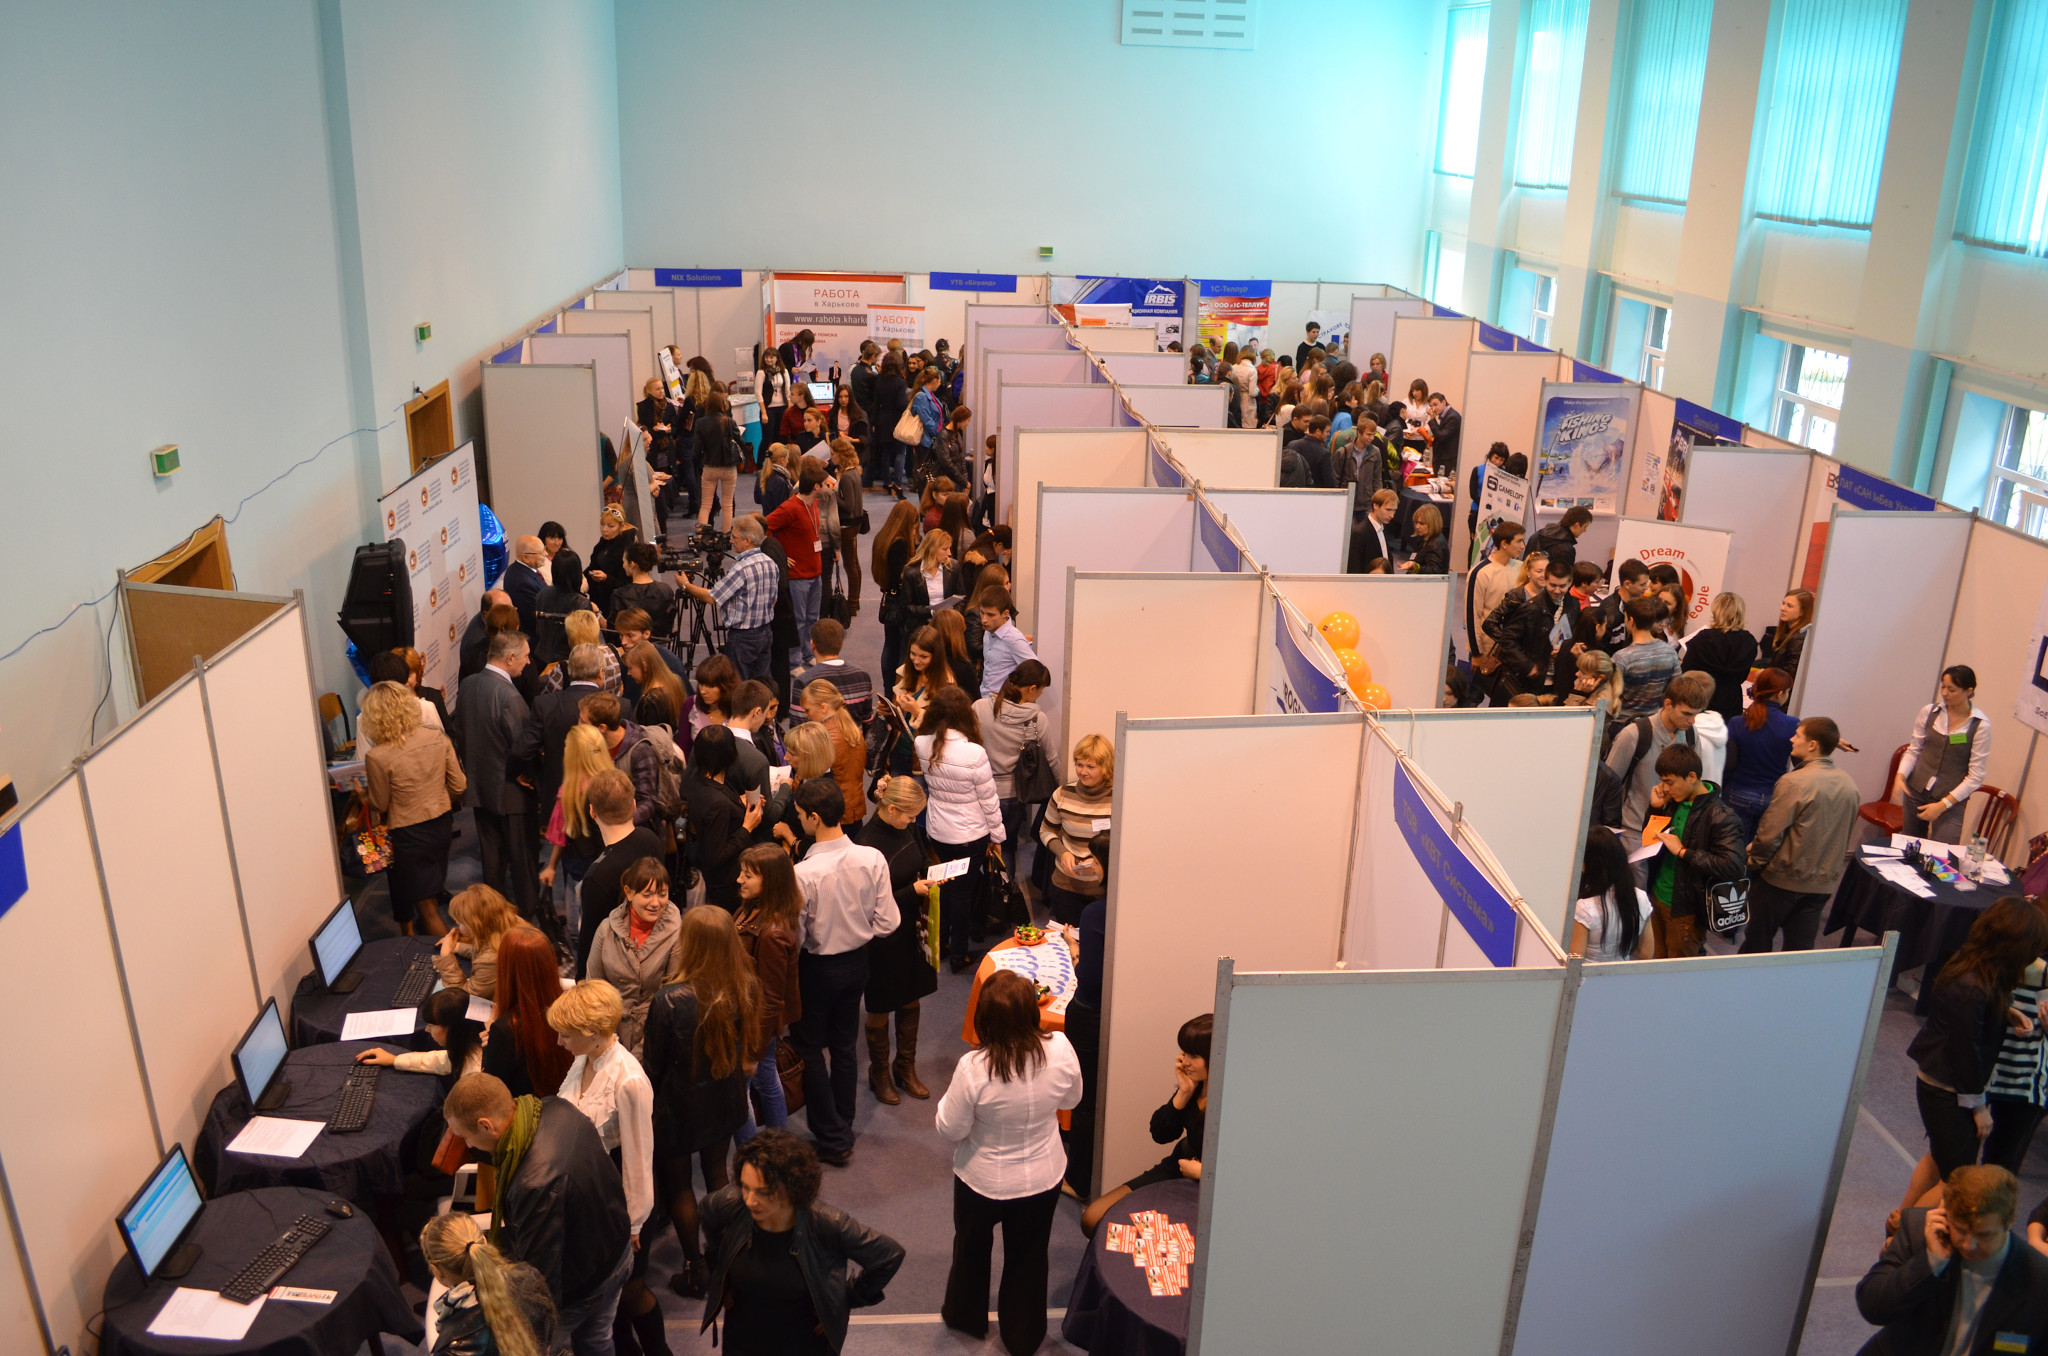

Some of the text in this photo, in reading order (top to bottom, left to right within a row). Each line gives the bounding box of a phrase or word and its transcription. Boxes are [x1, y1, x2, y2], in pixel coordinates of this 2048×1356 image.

[813, 288, 860, 299] РАБОТА
[1144, 295, 1176, 304] IRBIS
[821, 300, 860, 308] Харькове
[875, 315, 916, 325] РАБОТА
[882, 325, 916, 334] Харькове
[1560, 411, 1613, 431] FISHING
[1558, 422, 1609, 443] KINGS
[1498, 484, 1525, 501] GAMELOFT
[1640, 547, 1685, 561] Dream
[1403, 799, 1418, 835] ТОВ
[1443, 860, 1495, 933] Система»
[1717, 912, 1746, 927] adidas
